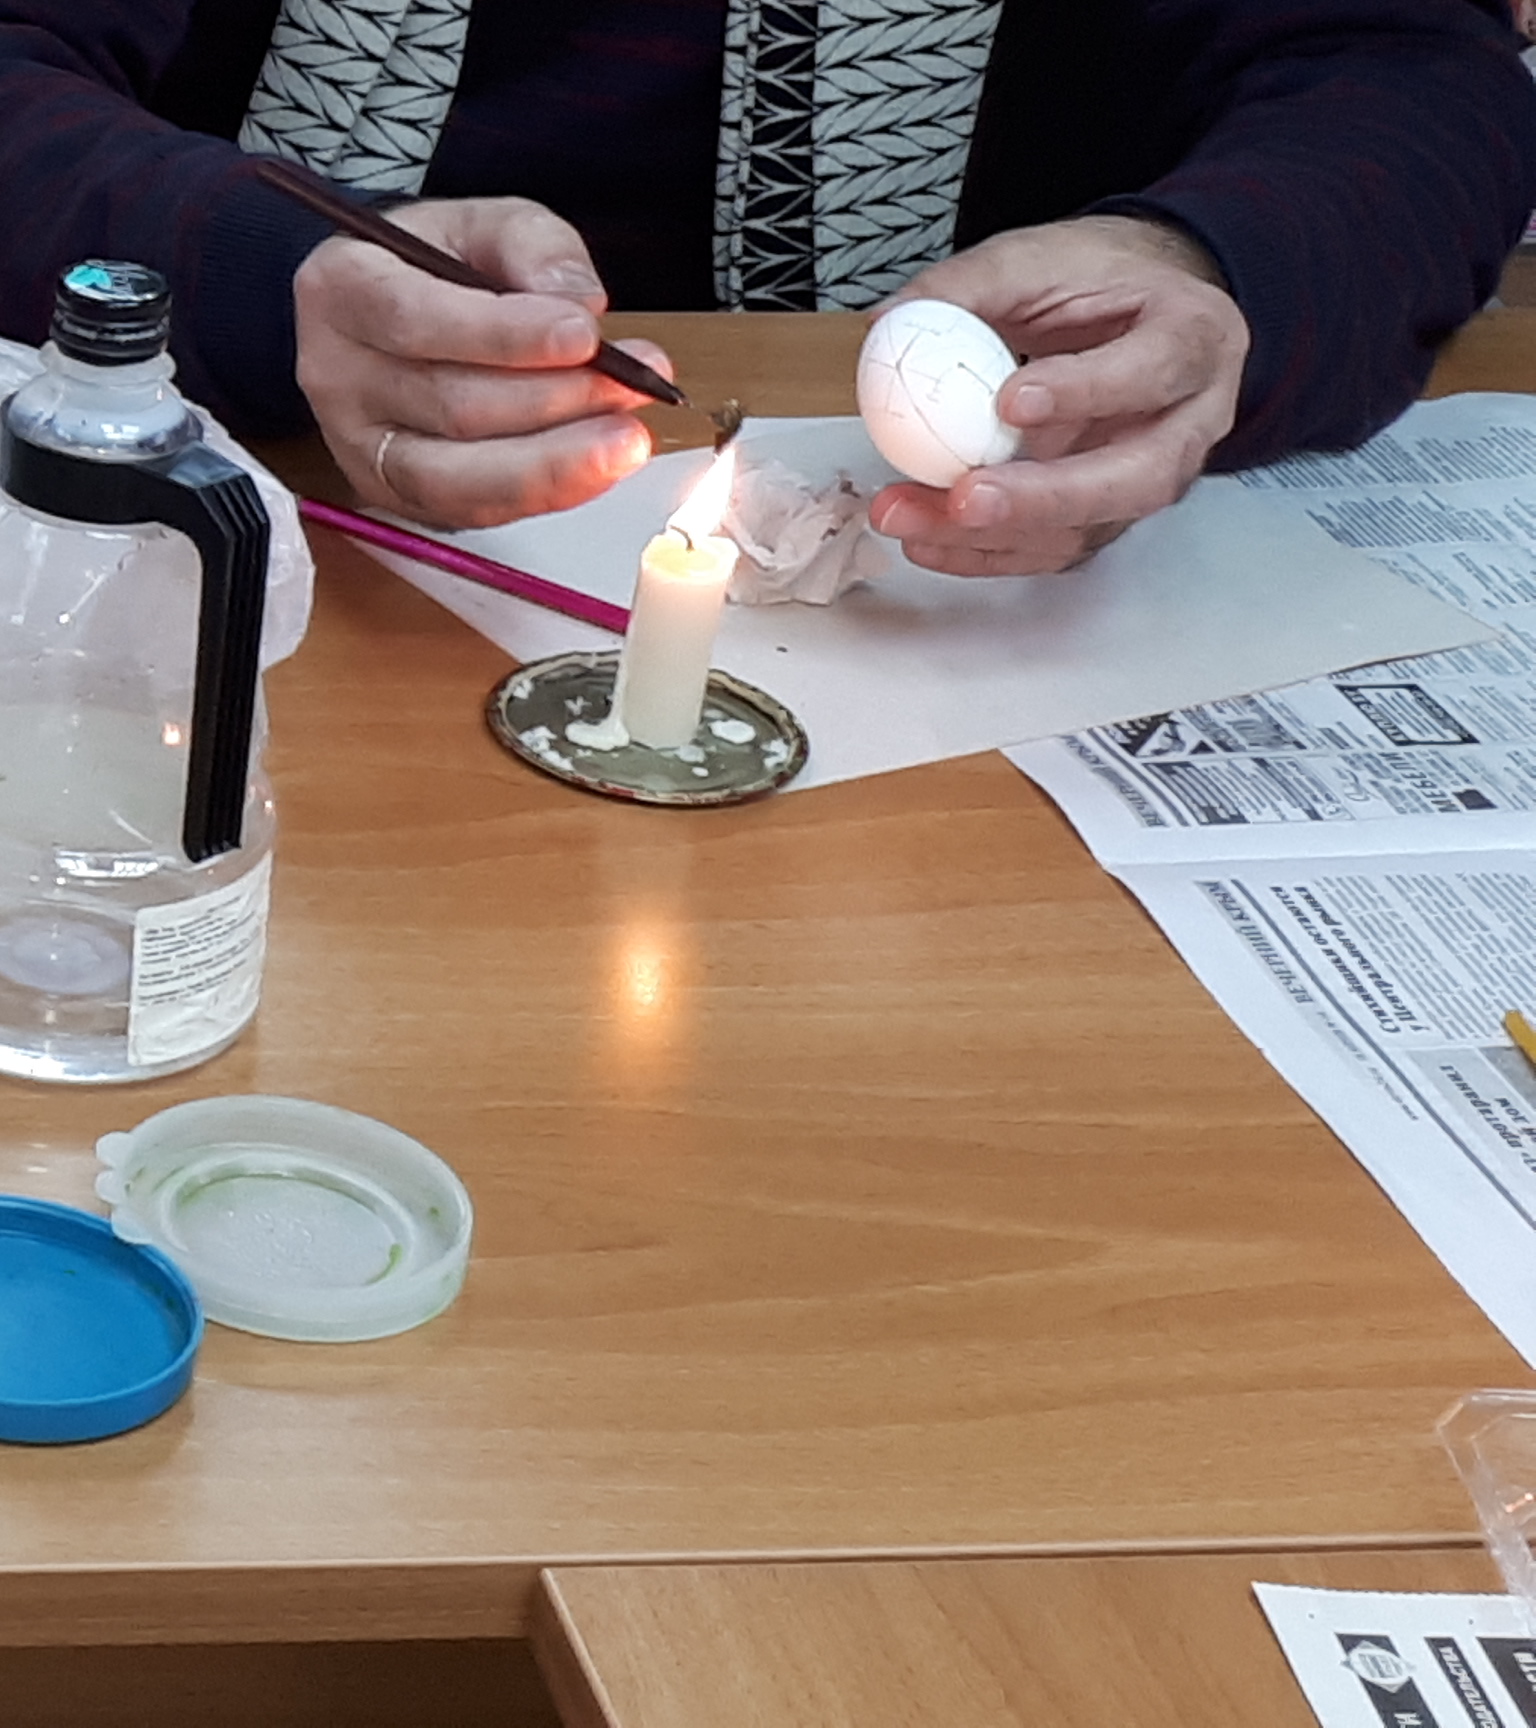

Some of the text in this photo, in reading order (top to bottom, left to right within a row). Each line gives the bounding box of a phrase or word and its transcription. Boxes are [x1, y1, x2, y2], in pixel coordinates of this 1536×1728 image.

[1196, 880, 1315, 1004] ВЕЧЕРНИЙ КРЫМ
[1270, 885, 1330, 947] остаются
[1292, 885, 1343, 927] рынка
[1330, 927, 1418, 1024] Центрального
